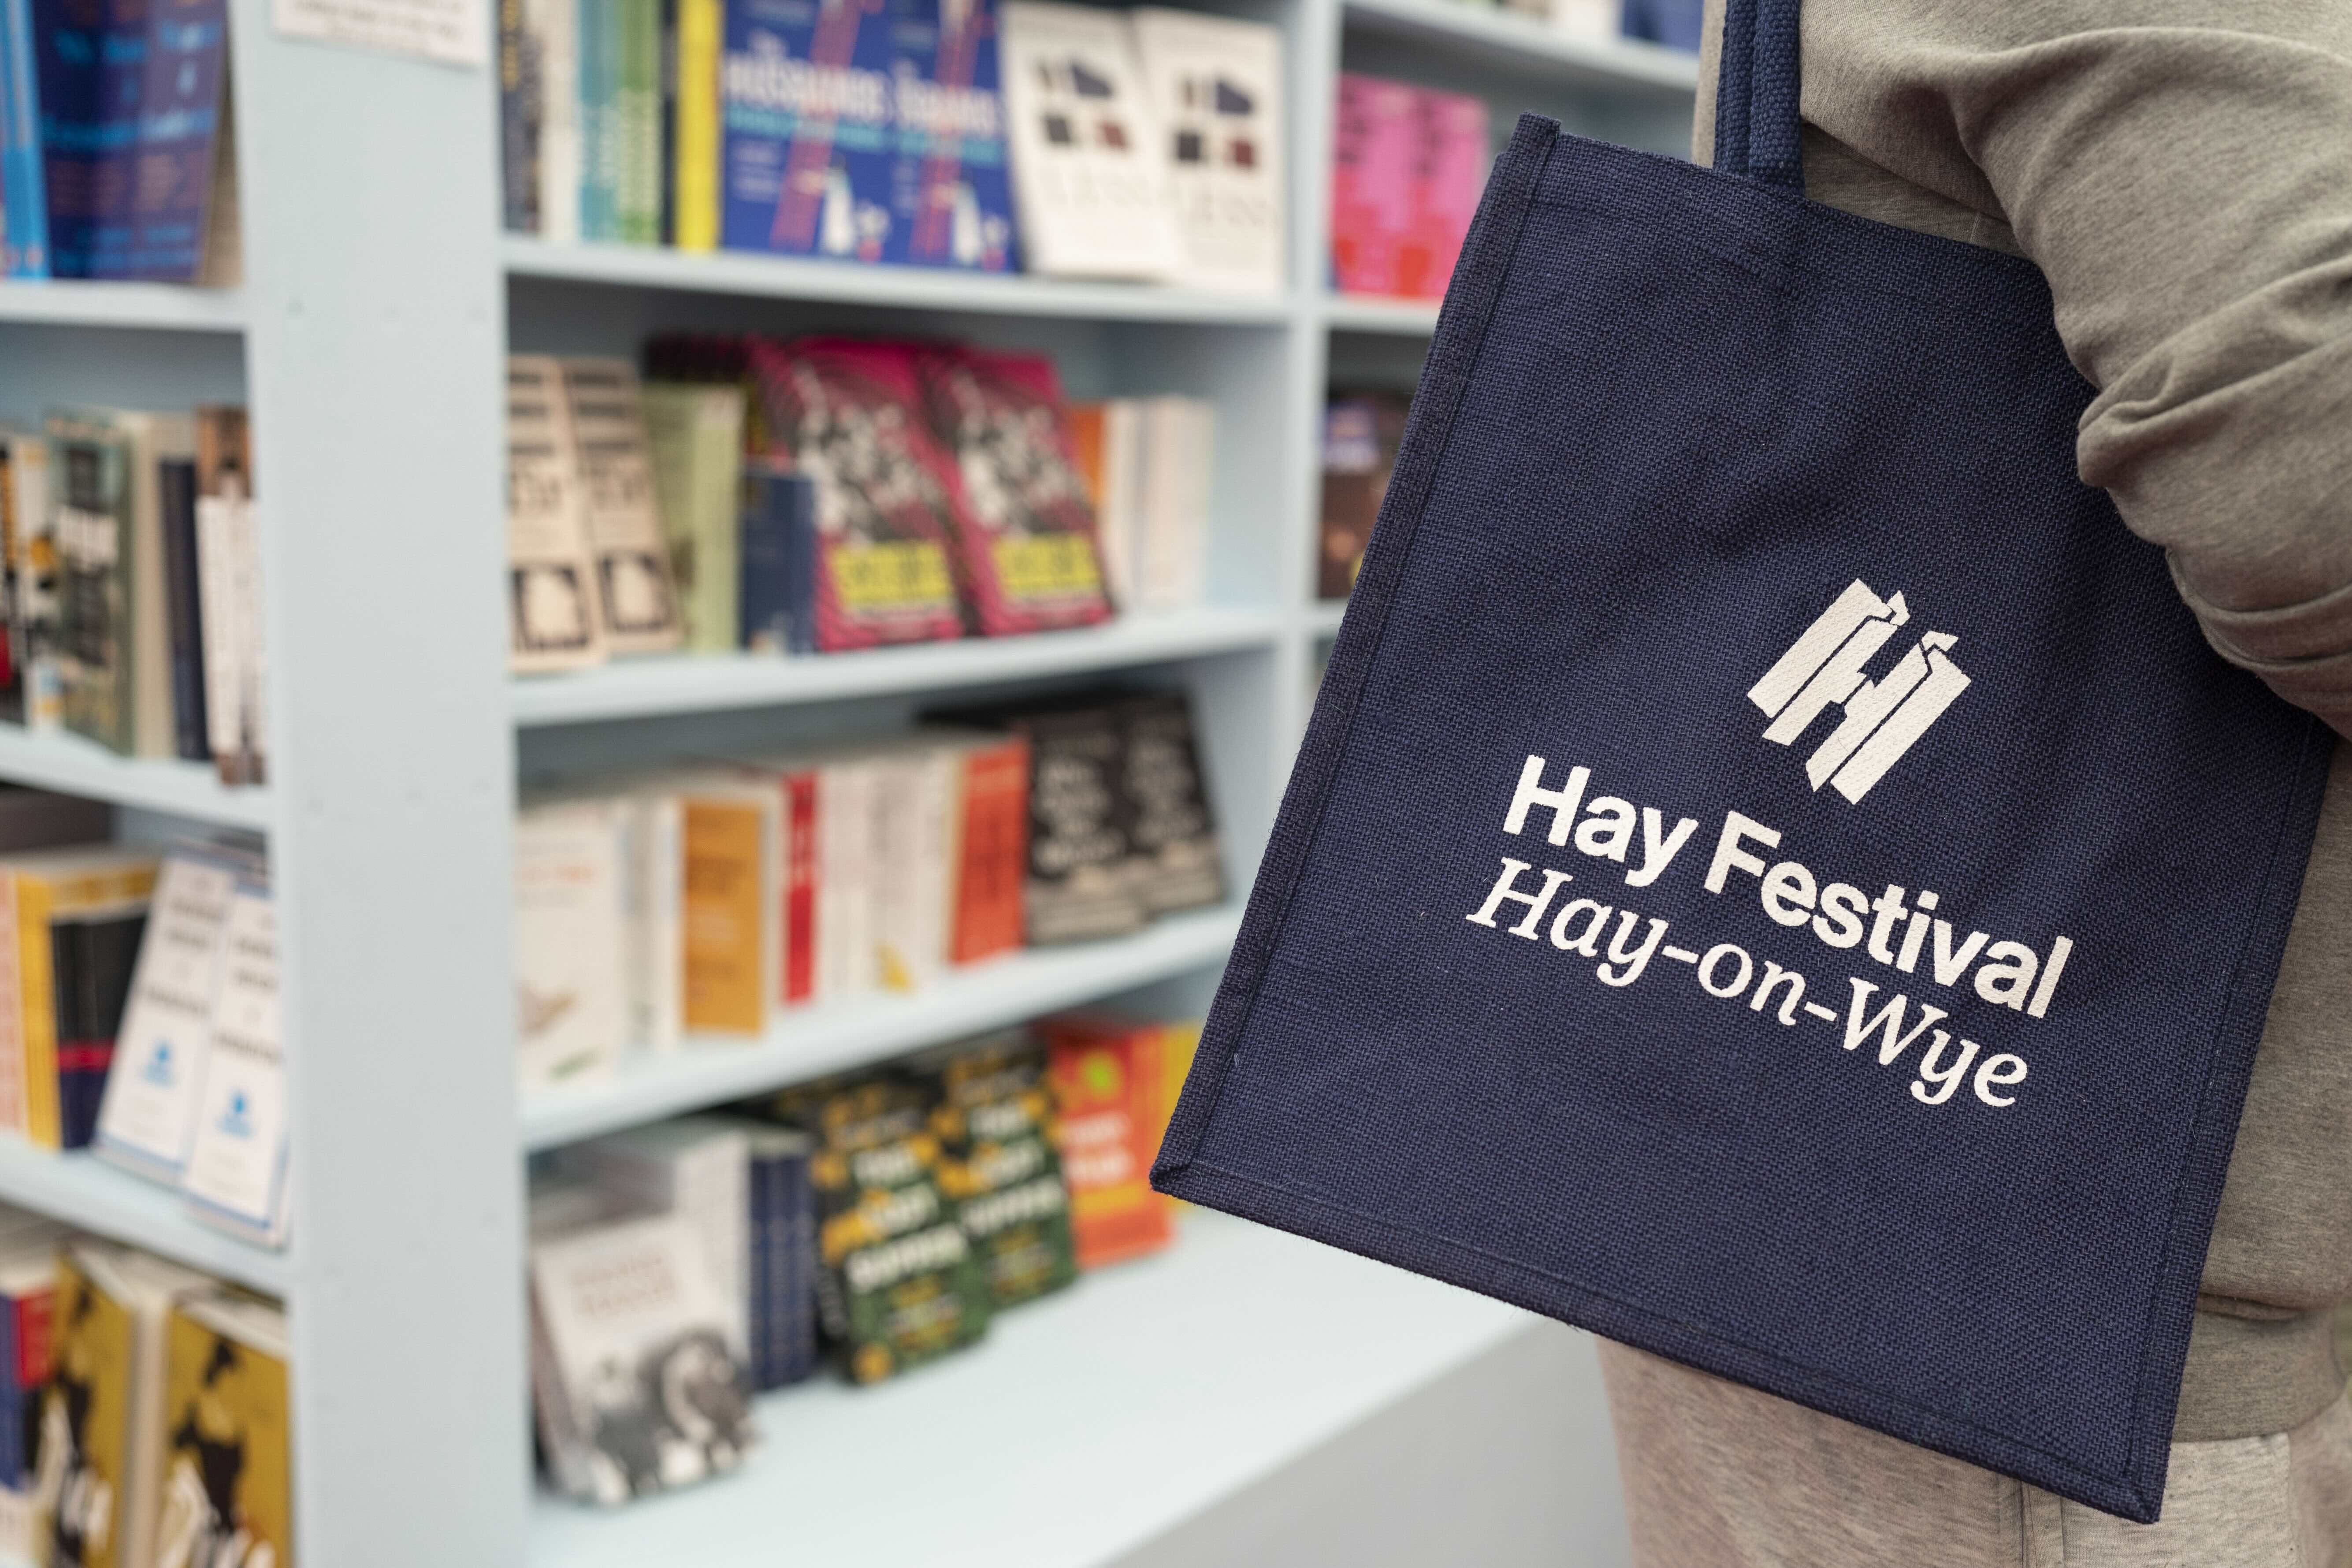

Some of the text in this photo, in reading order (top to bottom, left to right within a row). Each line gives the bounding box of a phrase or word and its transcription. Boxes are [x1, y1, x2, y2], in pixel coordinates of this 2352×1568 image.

[1465, 856, 2028, 1107] Hay-on-Wye
[1503, 754, 2073, 1019] Hay Festival
